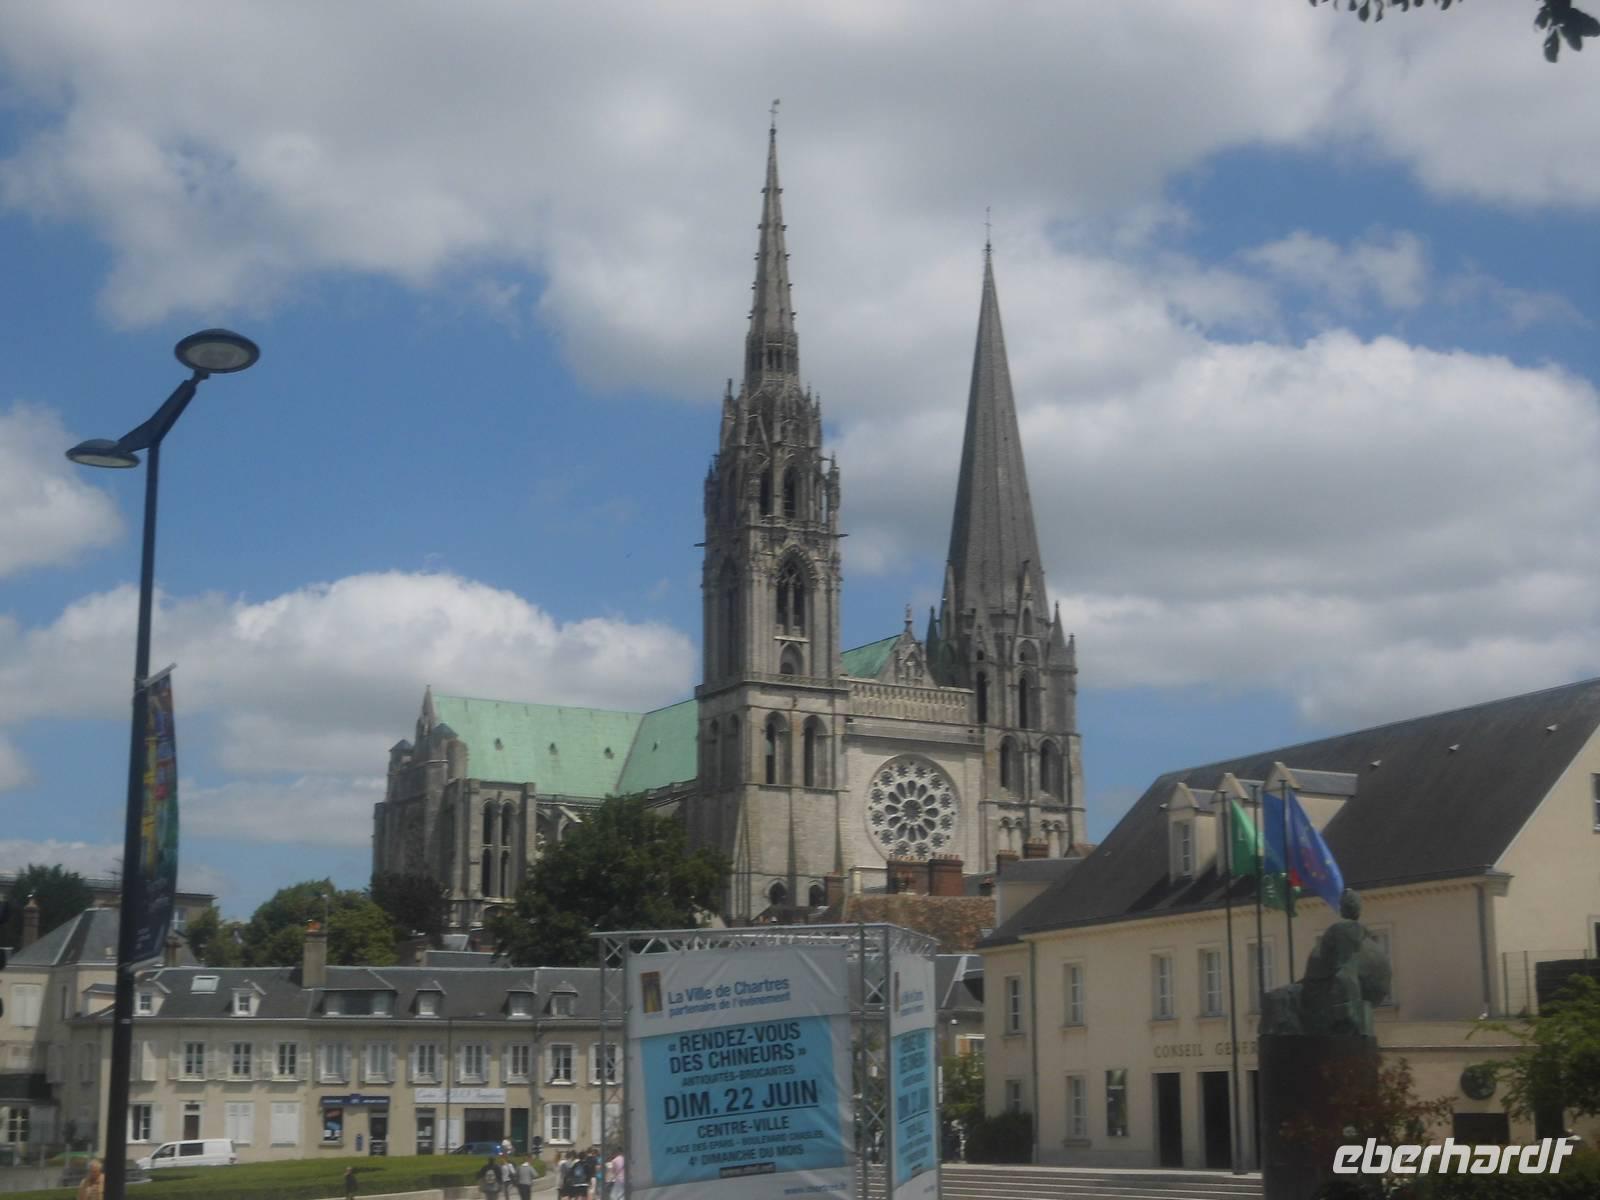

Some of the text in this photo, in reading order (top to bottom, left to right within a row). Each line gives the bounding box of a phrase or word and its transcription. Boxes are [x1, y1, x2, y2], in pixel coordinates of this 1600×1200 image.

[668, 978, 790, 1004] La Ville de Chartres
[719, 1000, 731, 1010] de
[679, 1022, 801, 1053] RENDEZ-VOUS
[670, 1054, 704, 1074] DES
[708, 1043, 795, 1069] CHINEURS
[1153, 1043, 1203, 1058] CONSEIL
[664, 1079, 818, 1120] DIM. 22 JUIN
[697, 1116, 790, 1139] CENTRE-VILLE
[692, 1141, 707, 1152] DES
[701, 1149, 757, 1165] DIMANCHE
[759, 1147, 776, 1159] DU
